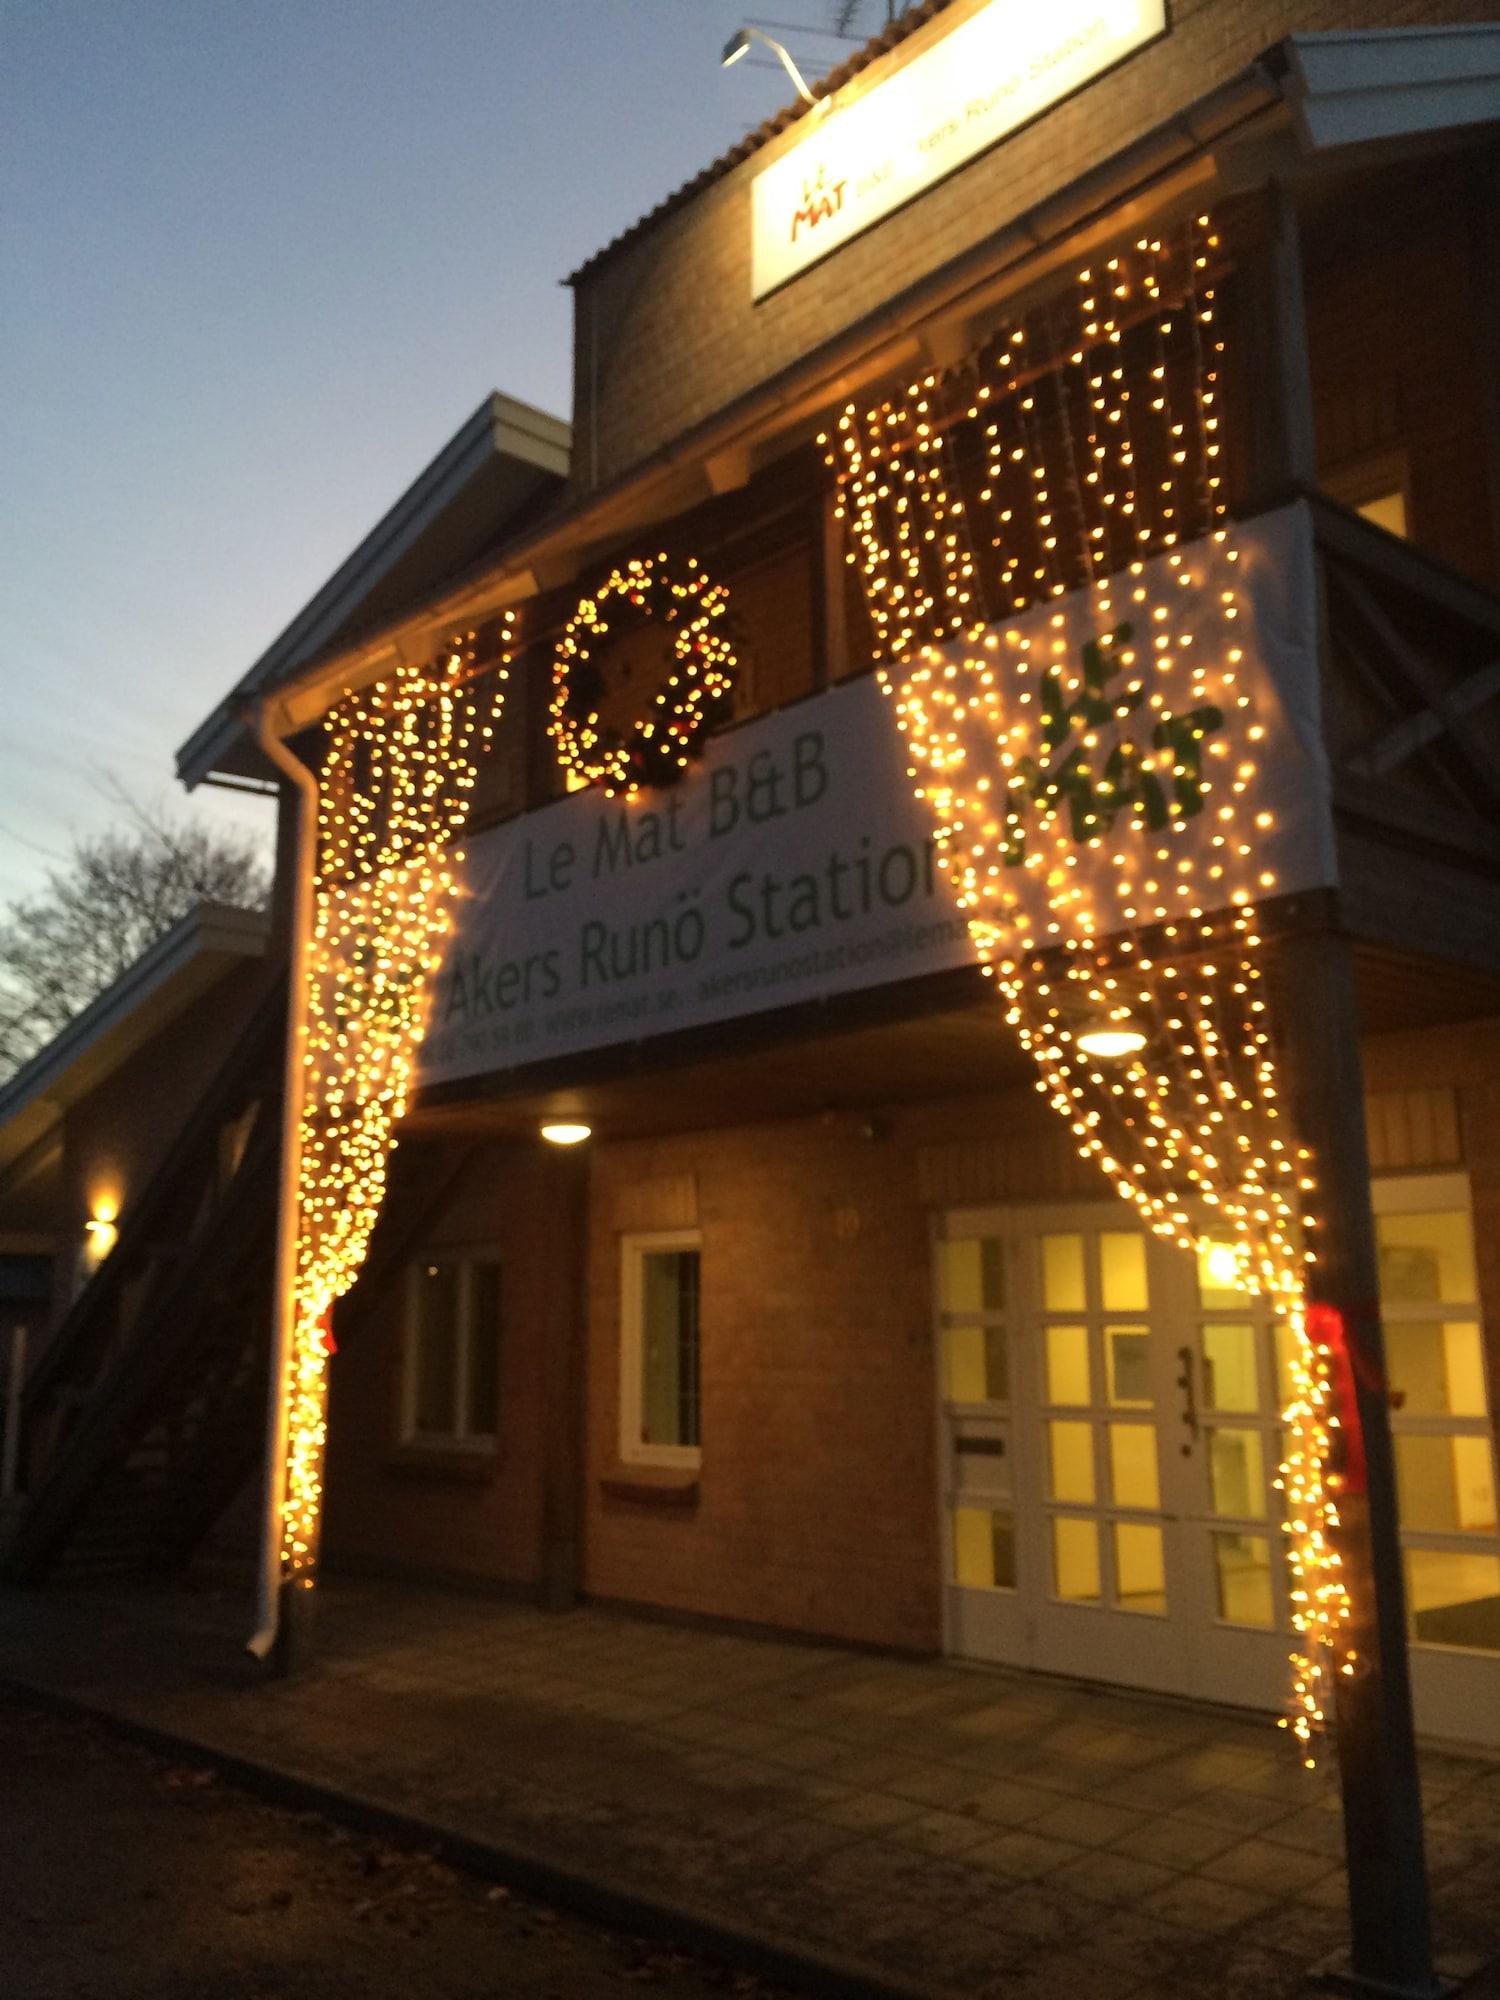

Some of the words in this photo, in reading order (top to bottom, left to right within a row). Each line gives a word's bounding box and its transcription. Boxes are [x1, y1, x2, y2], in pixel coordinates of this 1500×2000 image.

[791, 179, 848, 241] MAT
[523, 838, 577, 901] Le
[592, 797, 685, 879] Mat
[709, 731, 829, 838] B&B
[580, 888, 705, 986] Runö
